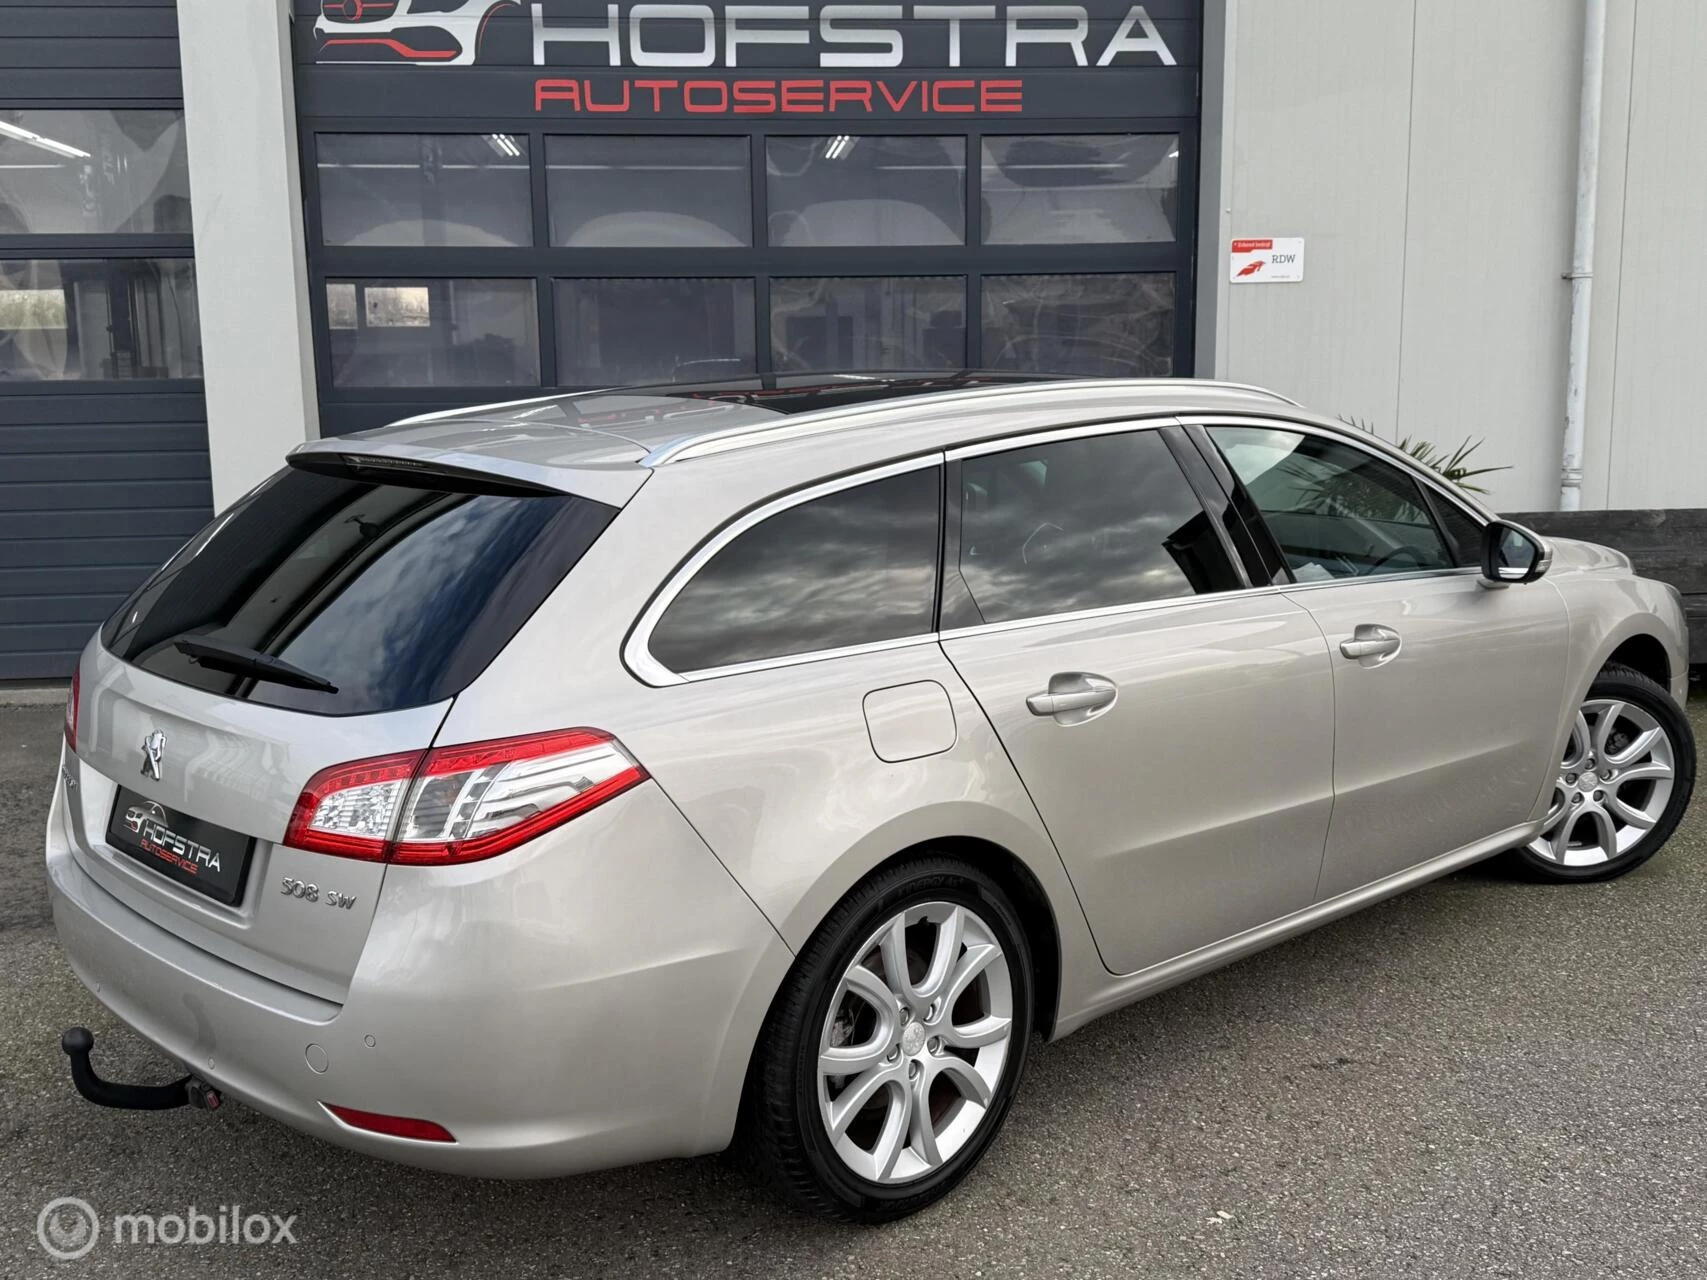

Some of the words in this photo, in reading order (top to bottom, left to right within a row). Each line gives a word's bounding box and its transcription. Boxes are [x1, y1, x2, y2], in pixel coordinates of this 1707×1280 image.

[530, 3, 1178, 68] HOFSTRA
[535, 79, 1023, 113] AUTOSERVICE
[1272, 254, 1296, 264] RDW
[140, 836, 198, 874] AUTOSERVICE
[143, 821, 221, 872] HOFSTRA
[281, 877, 319, 902] 508
[327, 890, 357, 910] SW
